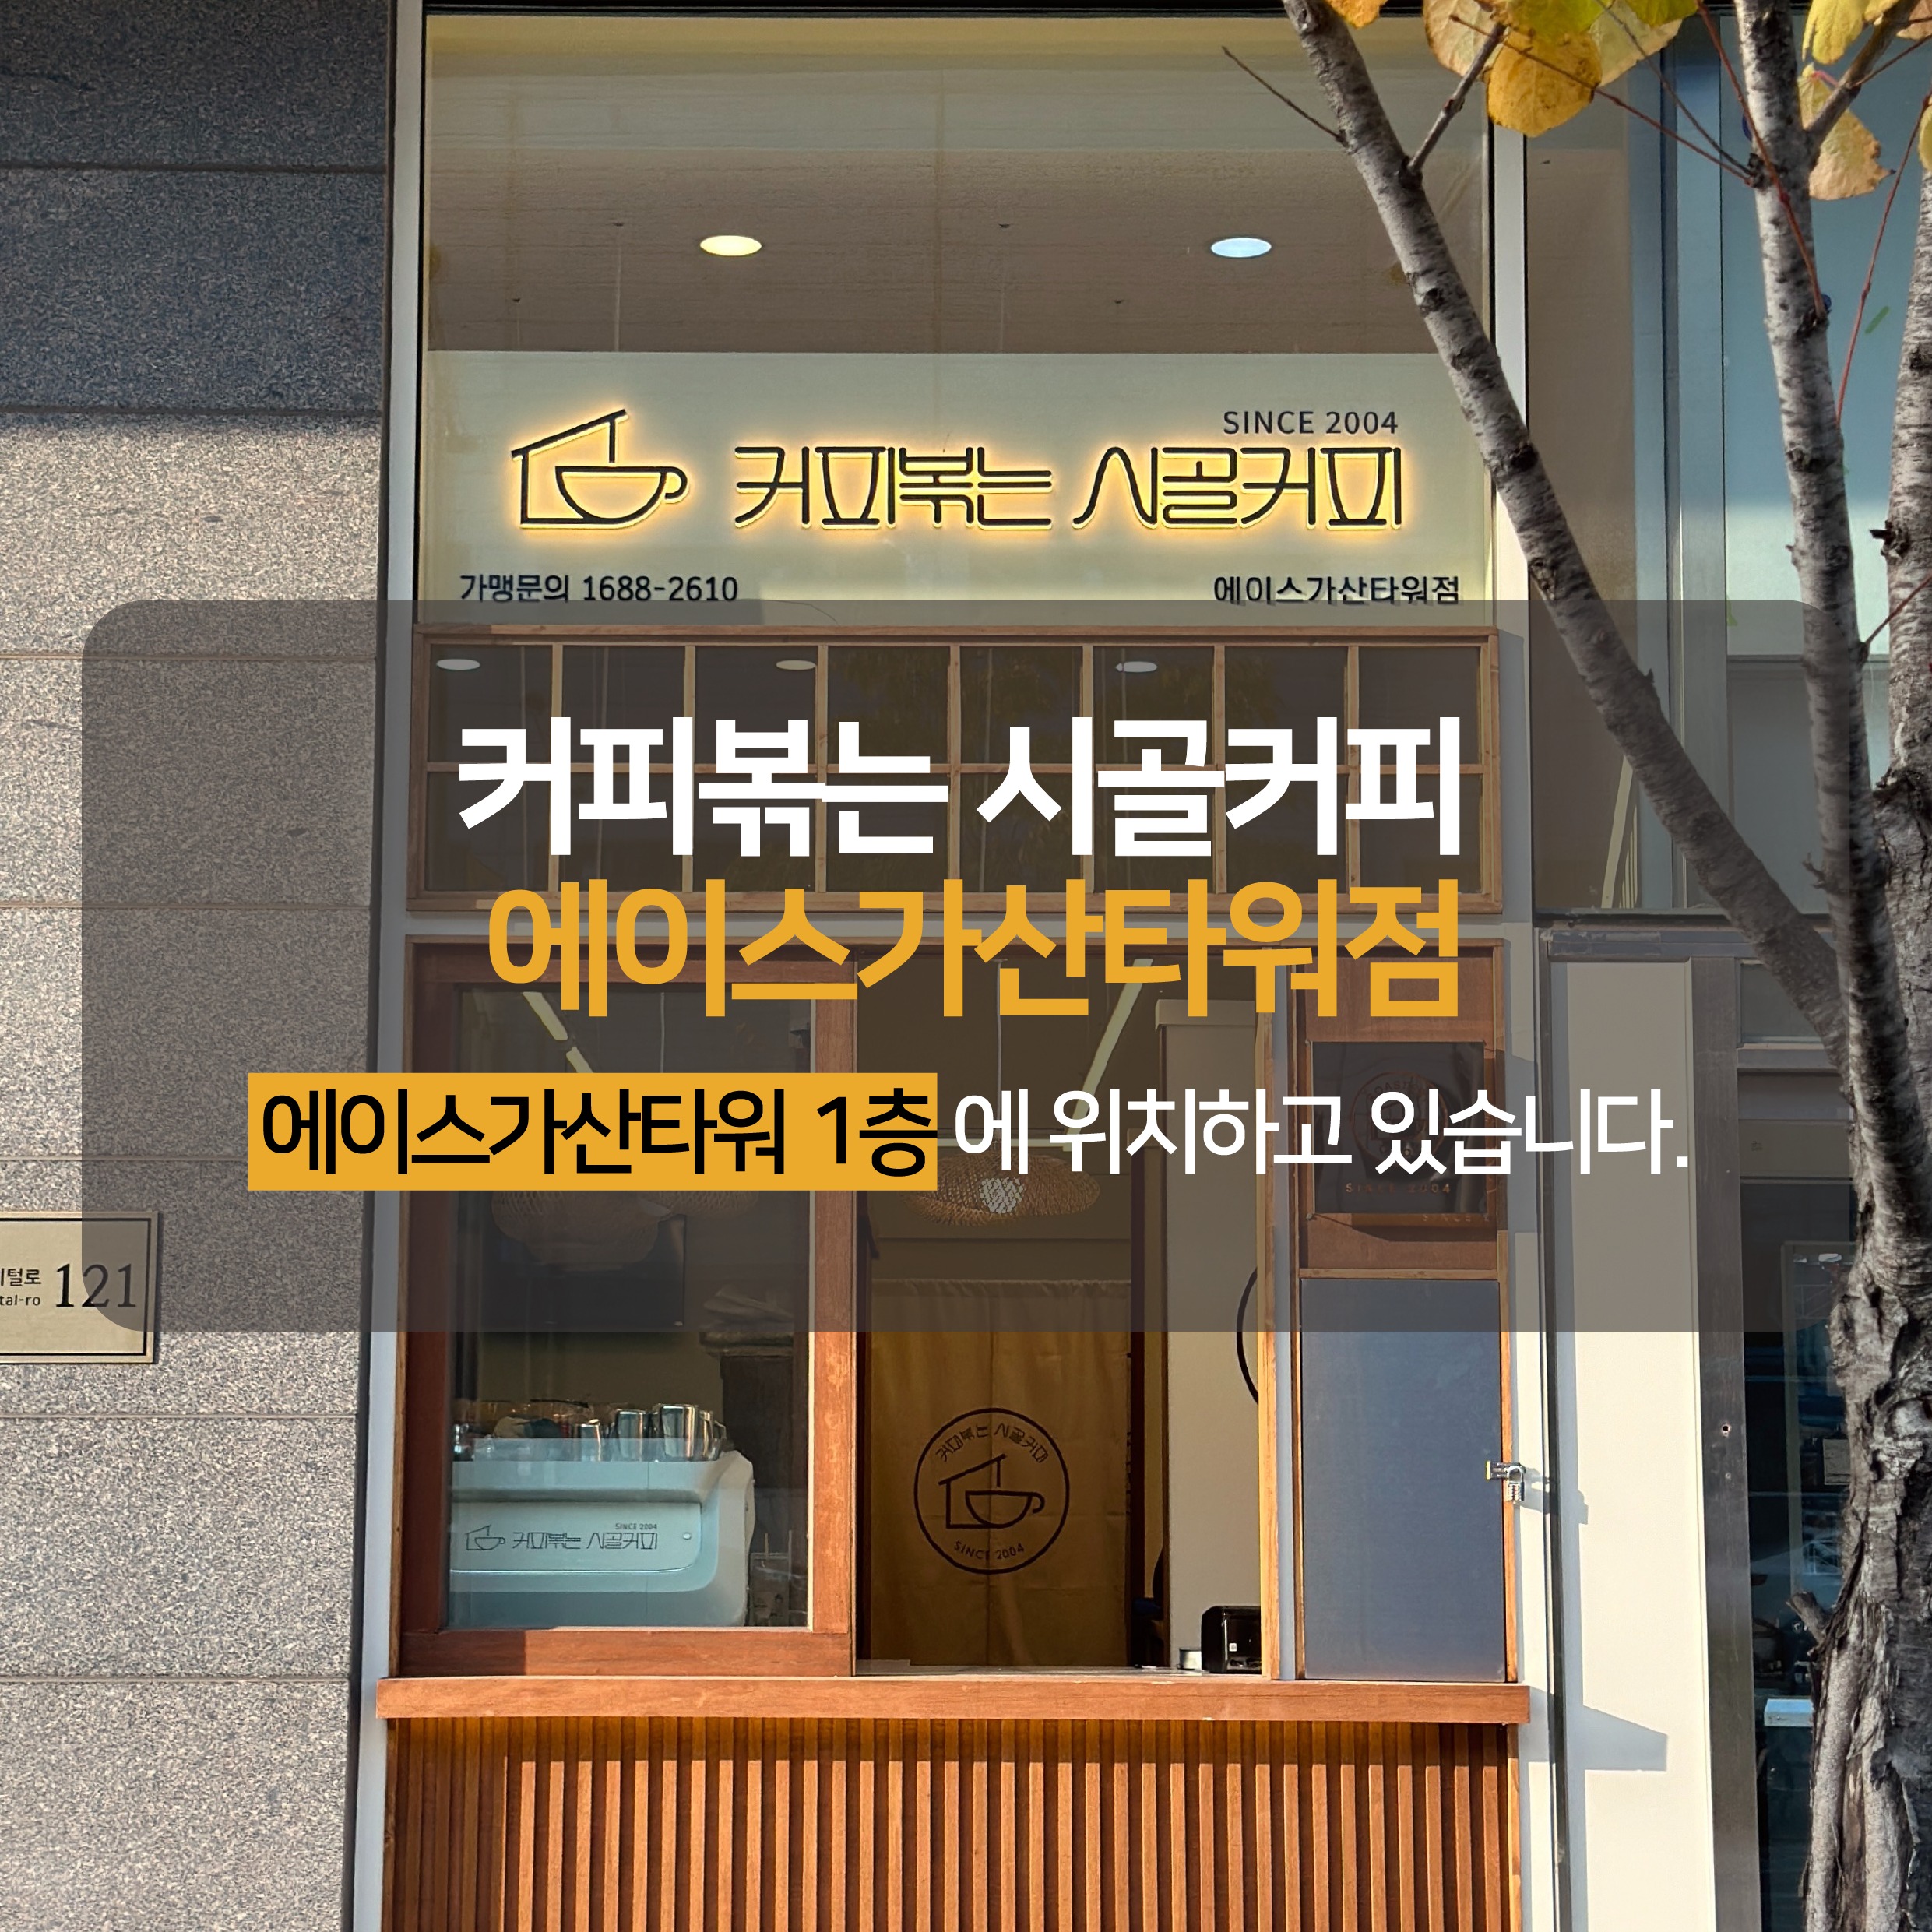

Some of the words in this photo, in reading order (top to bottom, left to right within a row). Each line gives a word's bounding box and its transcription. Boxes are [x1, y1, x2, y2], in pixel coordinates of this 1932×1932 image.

[1223, 410, 1314, 434] SINCE
[1326, 411, 1399, 434] 2004
[734, 445, 1052, 530] 커피볶는
[1072, 445, 1402, 530] 시골커피
[459, 574, 569, 603] 가맹문의
[583, 575, 738, 602] 1688-2610
[1213, 575, 1460, 605] 에이스가산타워점
[56, 1262, 137, 1308] 121
[994, 1543, 1025, 1560] 2004
